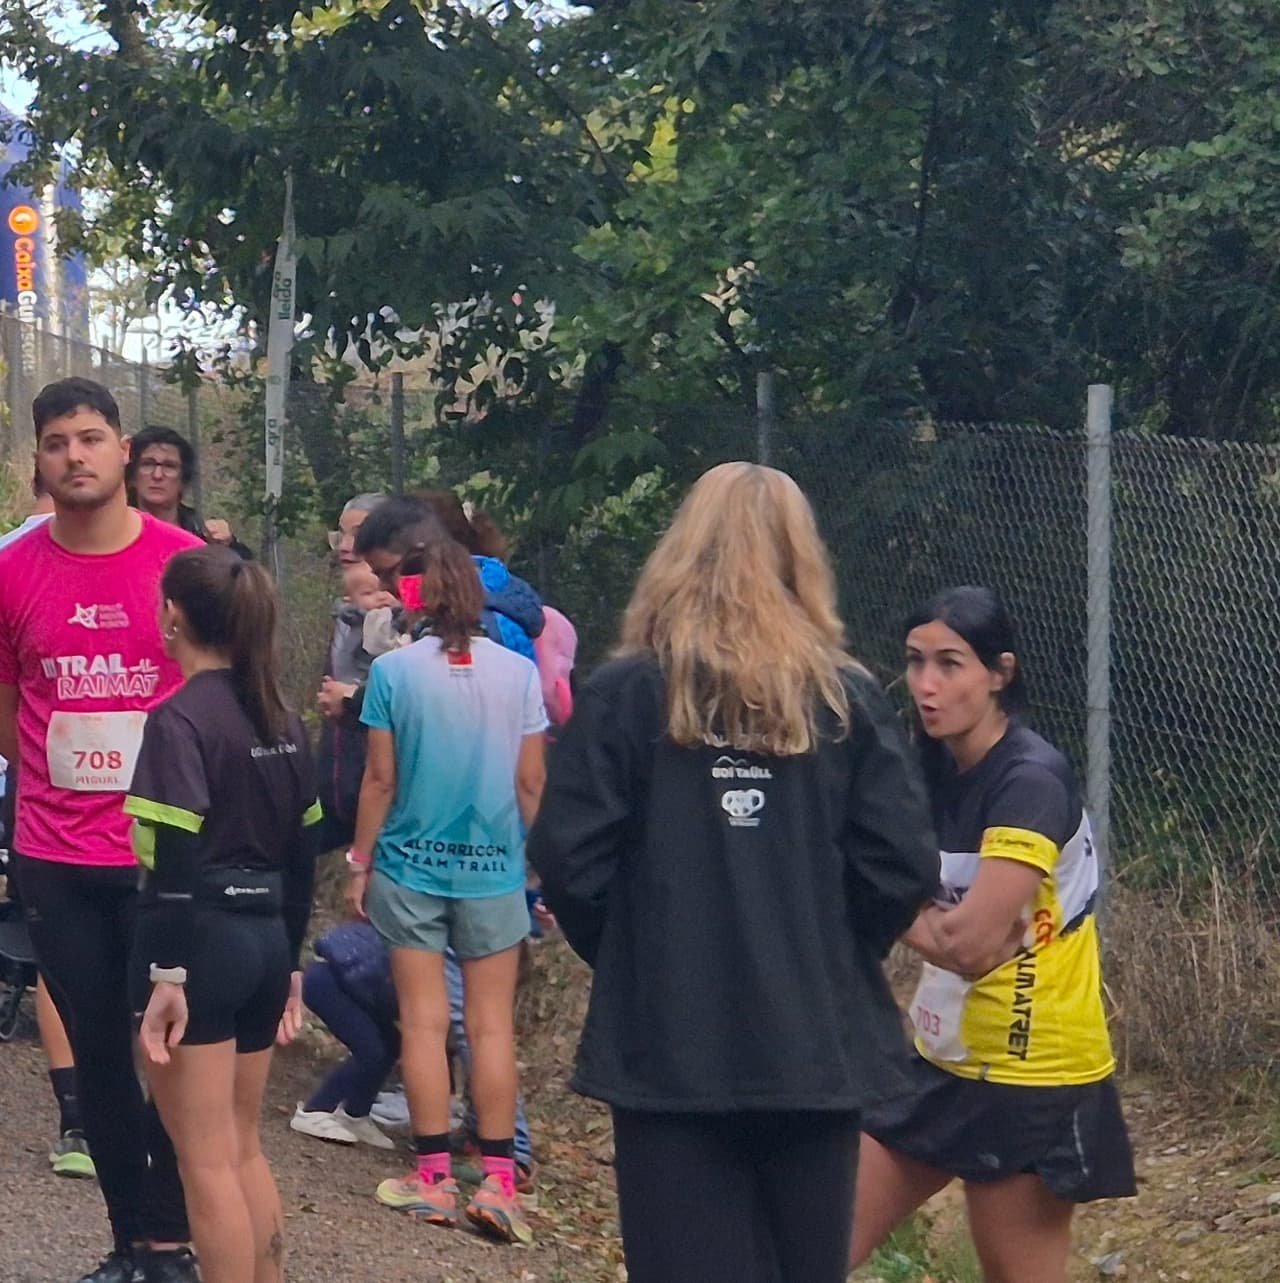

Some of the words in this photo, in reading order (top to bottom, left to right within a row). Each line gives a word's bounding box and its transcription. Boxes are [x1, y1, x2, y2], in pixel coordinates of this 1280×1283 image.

[57, 673, 160, 700] RAIMAT
[72, 750, 123, 770] 708
[458, 859, 508, 872] TRAIL
